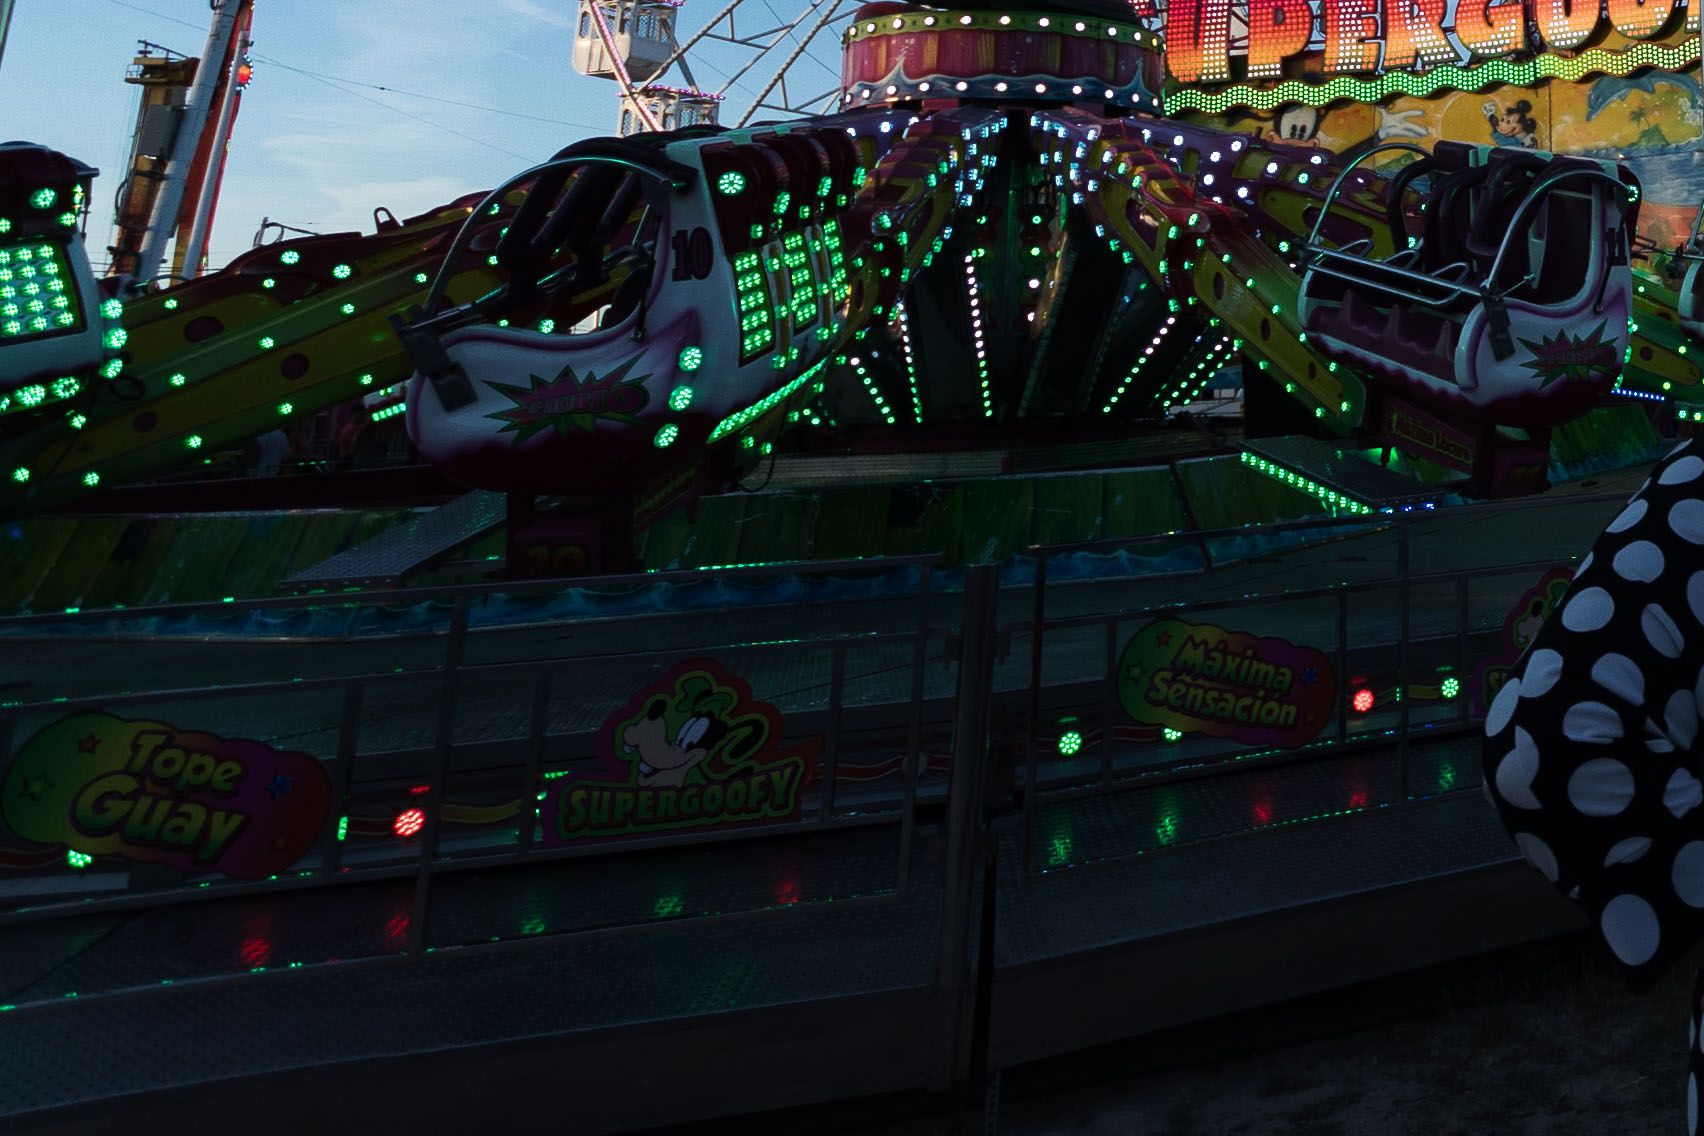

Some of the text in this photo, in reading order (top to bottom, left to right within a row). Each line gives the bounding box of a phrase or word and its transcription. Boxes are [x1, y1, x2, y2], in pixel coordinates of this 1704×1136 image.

[671, 227, 714, 283] 10
[1173, 636, 1295, 692] Máxima
[1148, 669, 1299, 728] Sensación
[125, 731, 247, 797] Tope
[72, 771, 251, 863] Guay
[567, 765, 796, 827] SUPERGOOFY
